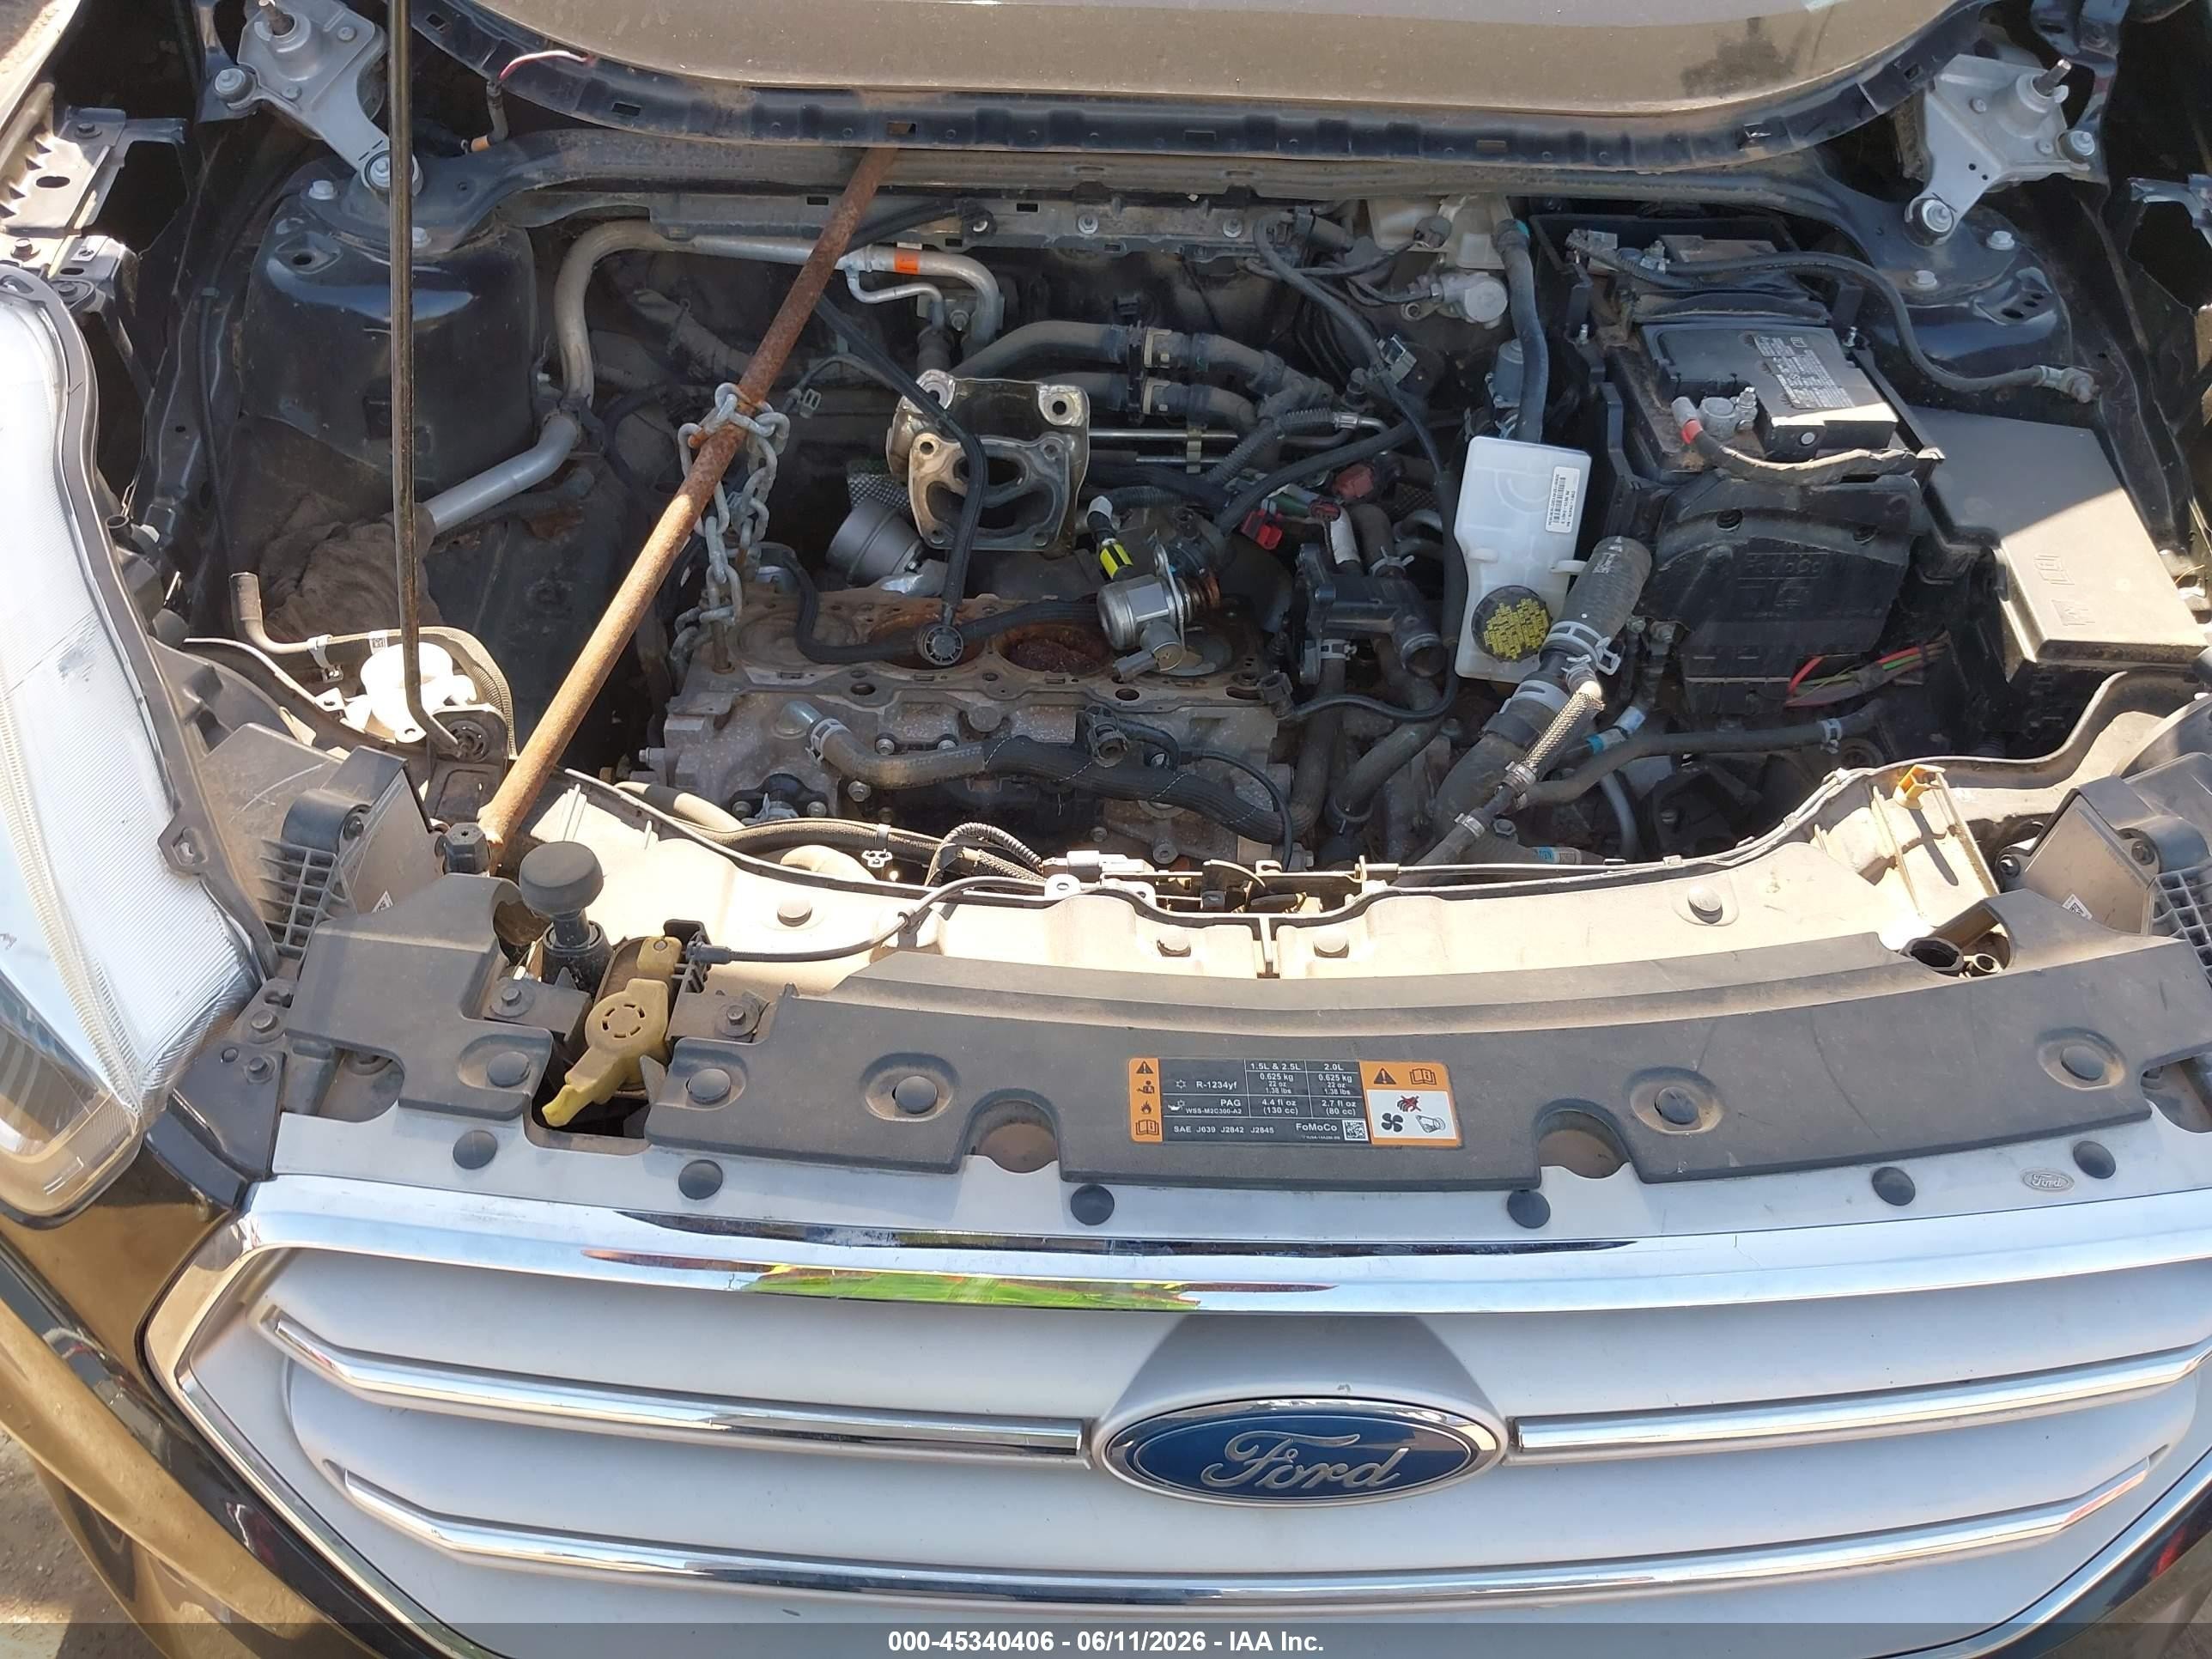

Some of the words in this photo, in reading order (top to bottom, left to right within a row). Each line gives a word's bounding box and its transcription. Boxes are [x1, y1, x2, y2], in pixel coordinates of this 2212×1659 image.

[1284, 1073, 1293, 1082] kg
[1341, 1074, 1352, 1083] kg
[1195, 1080, 1237, 1091] R-1234yf
[1263, 1106, 1282, 1115] (130
[1285, 1107, 1298, 1115] cc)
[1341, 1108, 1356, 1116] cc)
[1295, 1123, 1338, 1132] FoMoCo
[2031, 1173, 2063, 1188] Ford
[1200, 1430, 1410, 1489] Ford
